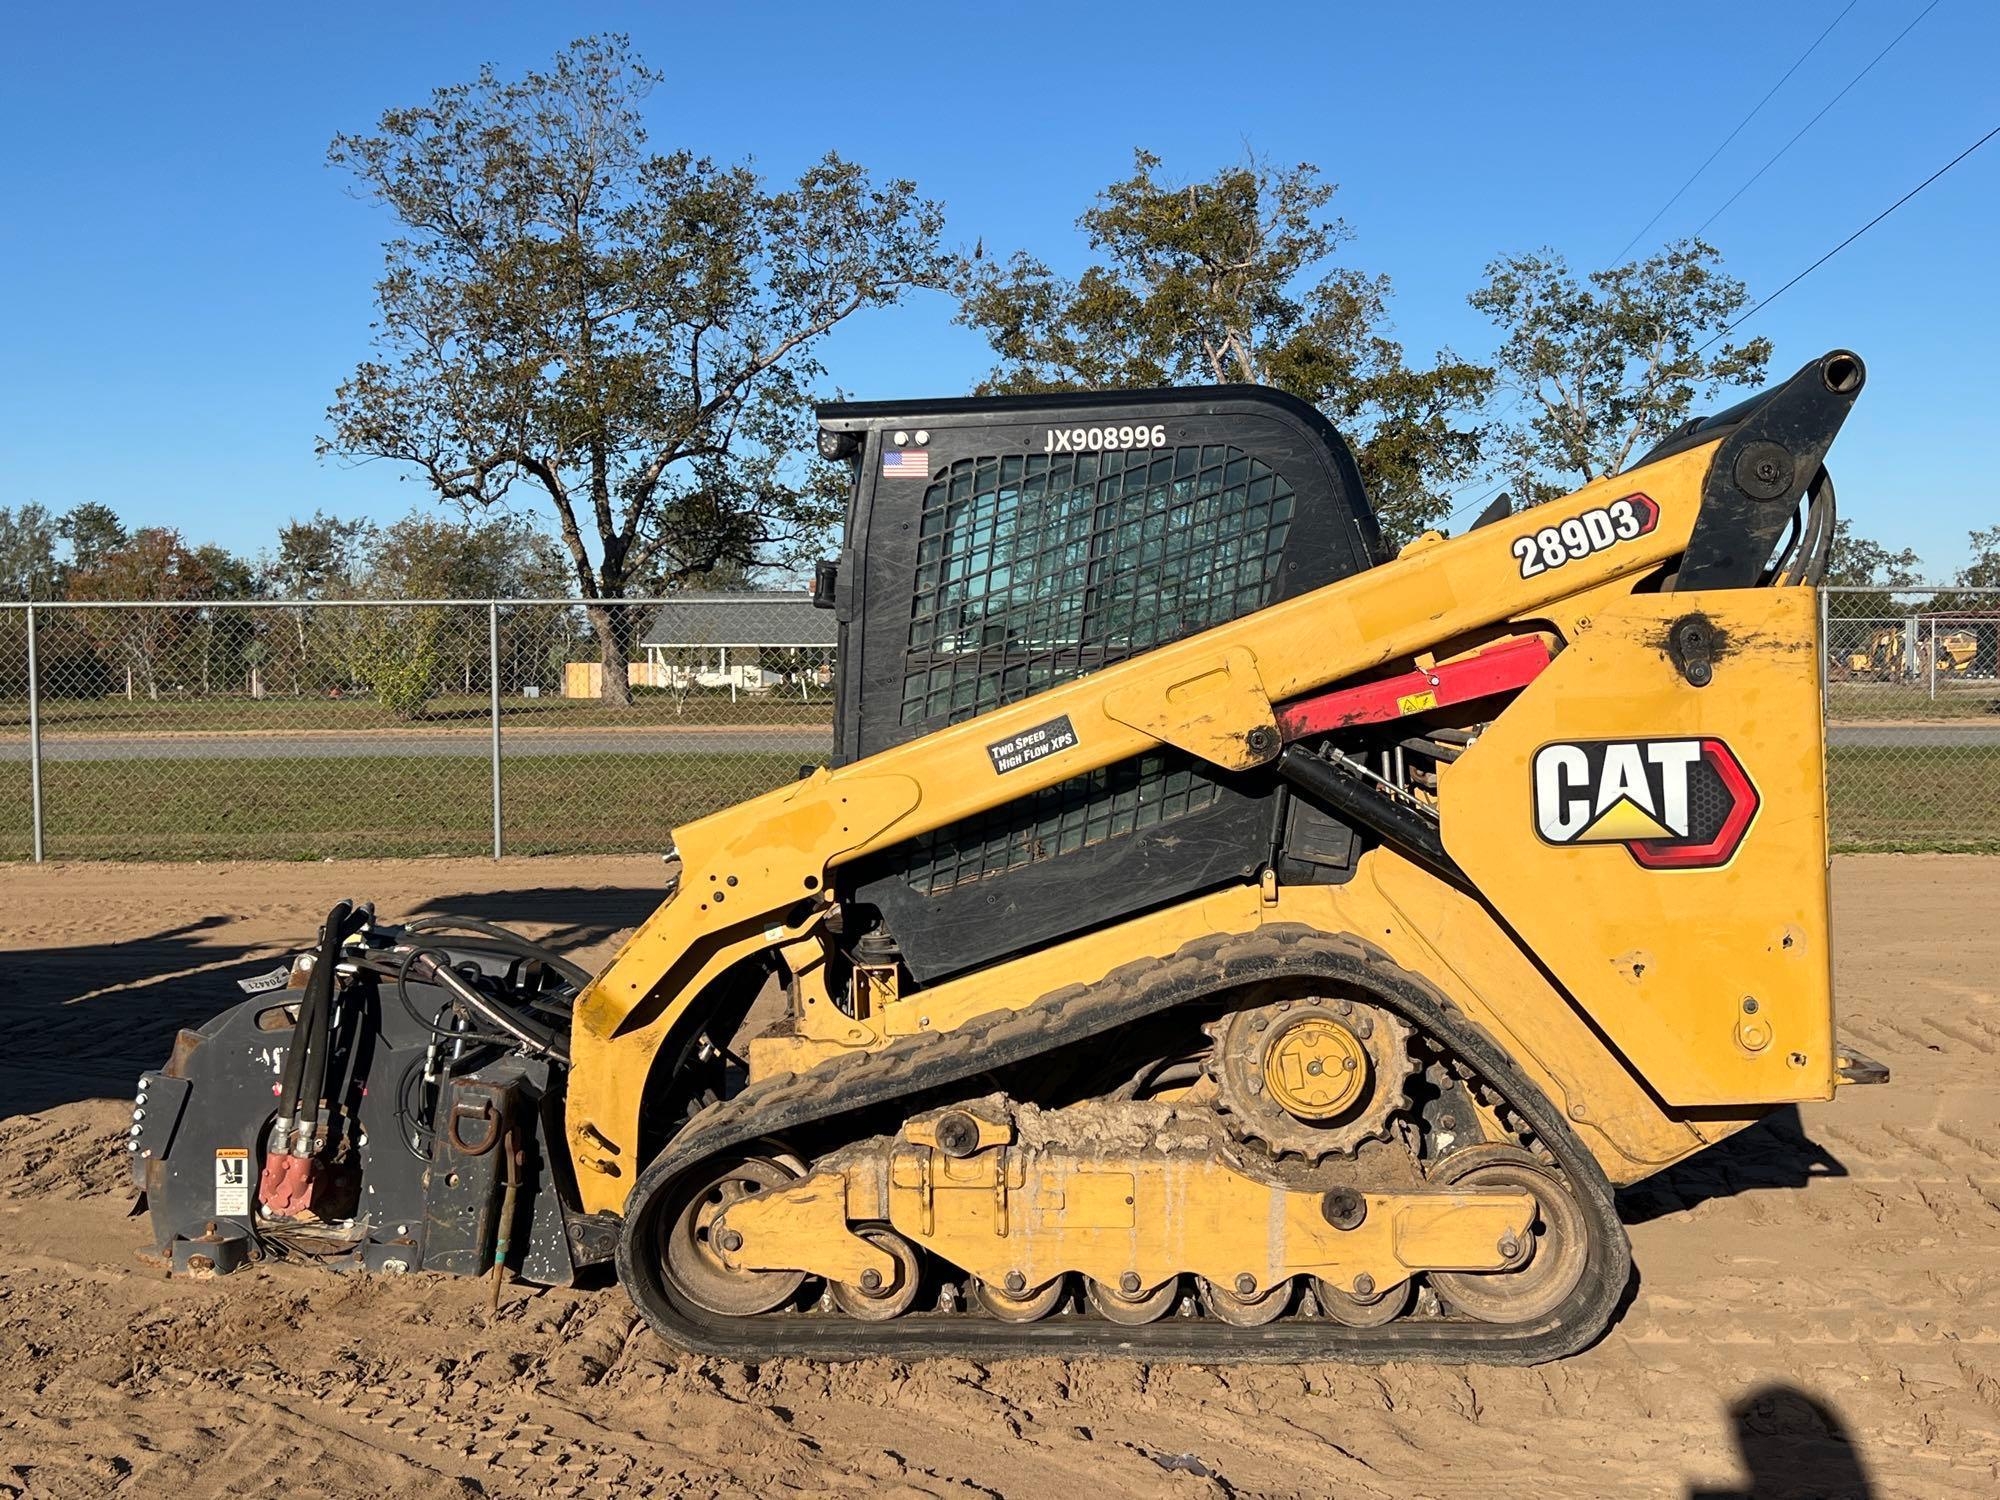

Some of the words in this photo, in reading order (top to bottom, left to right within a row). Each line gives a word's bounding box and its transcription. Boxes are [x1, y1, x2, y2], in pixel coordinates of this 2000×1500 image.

[1044, 425, 1166, 452] JX908996
[1513, 500, 1640, 578] 289D3
[992, 743, 1014, 759] TWO
[1015, 730, 1046, 750] SPEED
[998, 754, 1022, 772] HIGH
[1023, 743, 1049, 762] FLOW
[1051, 732, 1073, 751] XPS
[1536, 741, 1700, 841] CAT
[248, 976, 282, 989] 204421
